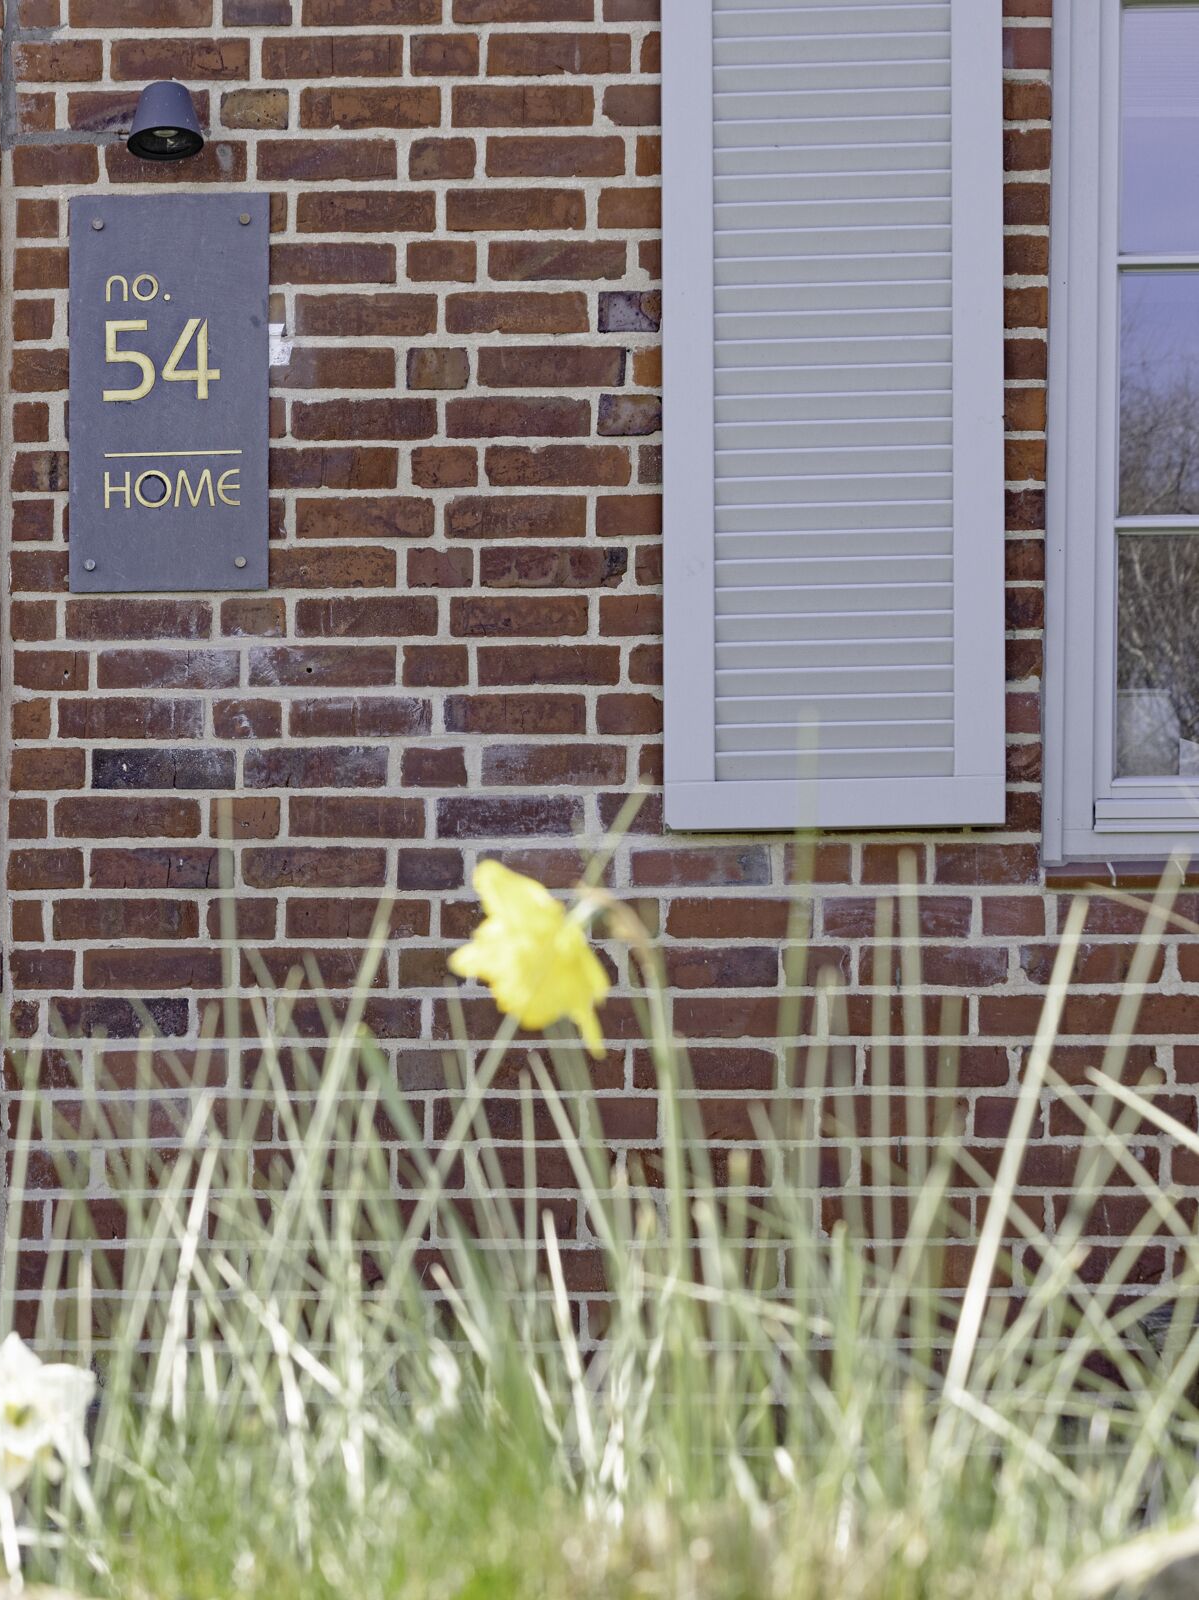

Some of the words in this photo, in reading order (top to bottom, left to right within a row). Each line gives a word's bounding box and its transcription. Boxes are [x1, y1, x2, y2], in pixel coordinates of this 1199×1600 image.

[105, 273, 171, 302] no.
[103, 318, 221, 402] 54
[104, 468, 241, 508] HOME
